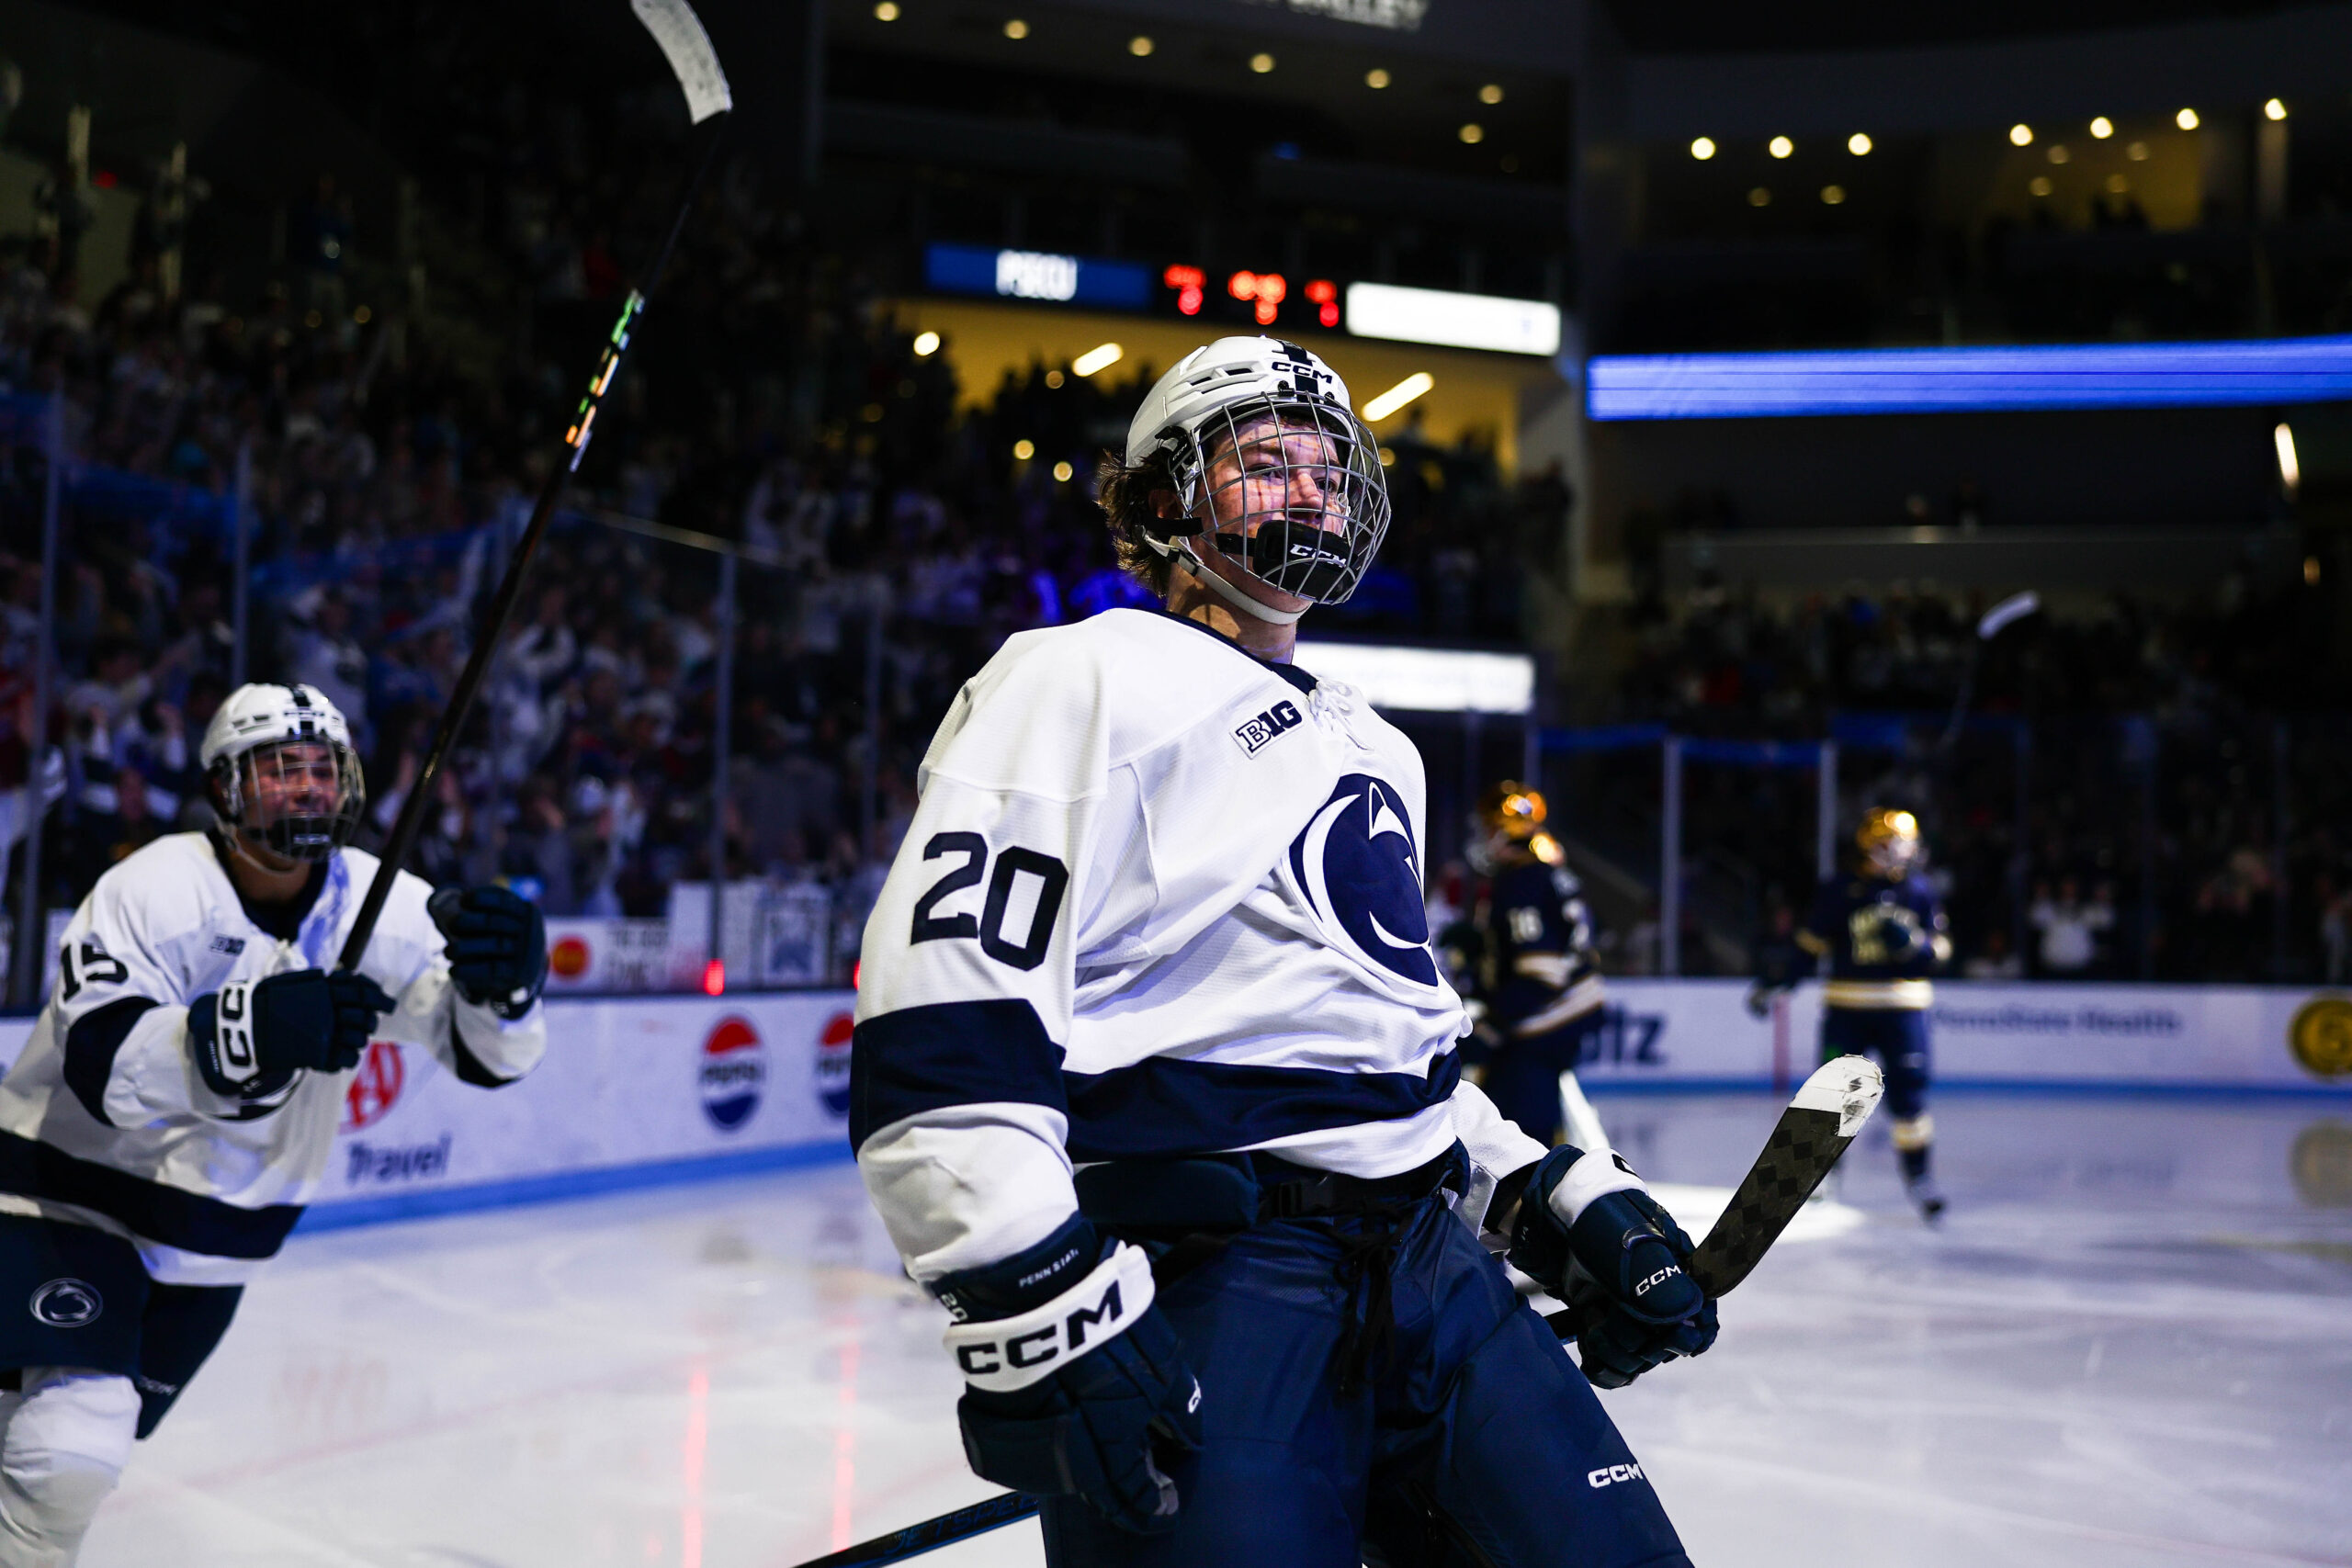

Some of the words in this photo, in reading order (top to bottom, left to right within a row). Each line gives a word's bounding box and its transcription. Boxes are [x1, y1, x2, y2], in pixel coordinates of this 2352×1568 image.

[1272, 361, 1333, 384] CCM
[1289, 543, 1347, 568] CCM
[910, 831, 1069, 972] 20
[61, 942, 129, 1002] 15
[347, 1133, 452, 1185] Travel
[1018, 1266, 1053, 1289] PENN
[1634, 1265, 1682, 1297] CCM
[956, 1280, 1123, 1375] CCM
[1588, 1463, 1644, 1488] CCM
[884, 1490, 1040, 1554] JETSPEE
